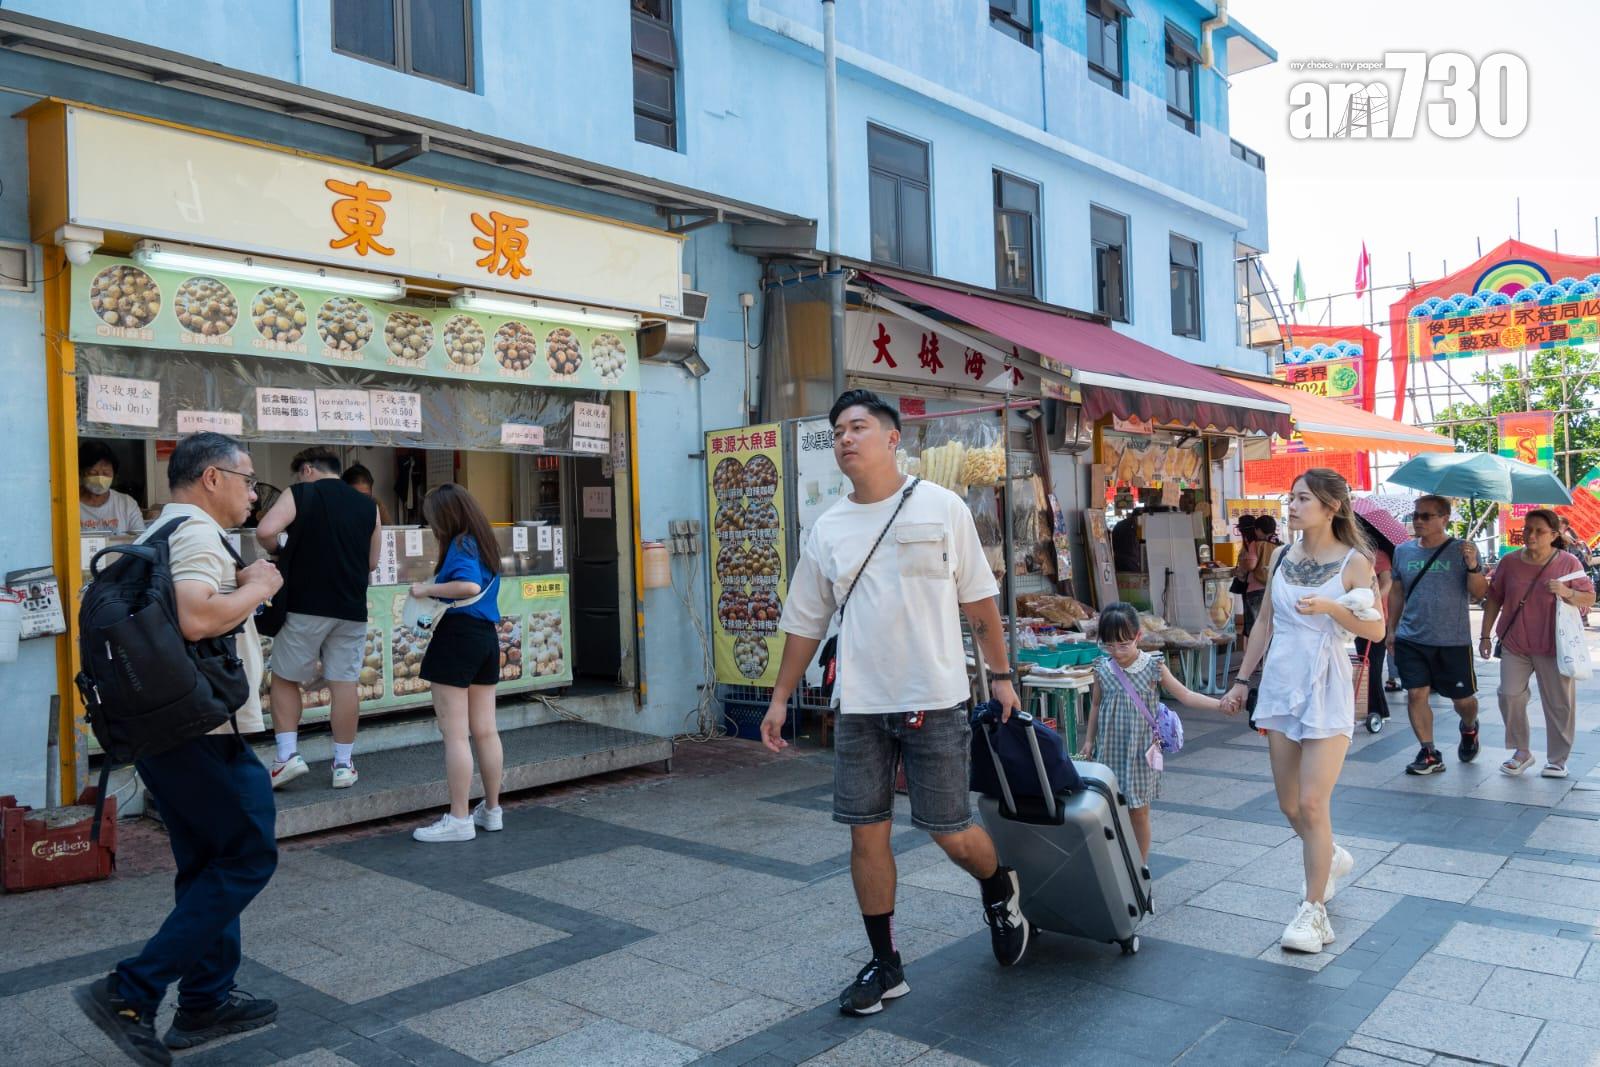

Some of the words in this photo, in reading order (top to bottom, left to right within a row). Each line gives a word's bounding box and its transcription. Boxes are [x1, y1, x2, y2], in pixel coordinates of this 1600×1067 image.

[325, 178, 532, 280] 東源
[99, 384, 153, 400] 只收現金
[127, 402, 152, 416] Only
[711, 430, 777, 455] 東源大魚蛋
[1407, 560, 1450, 572] RUN
[31, 838, 91, 858] Carlsberg
